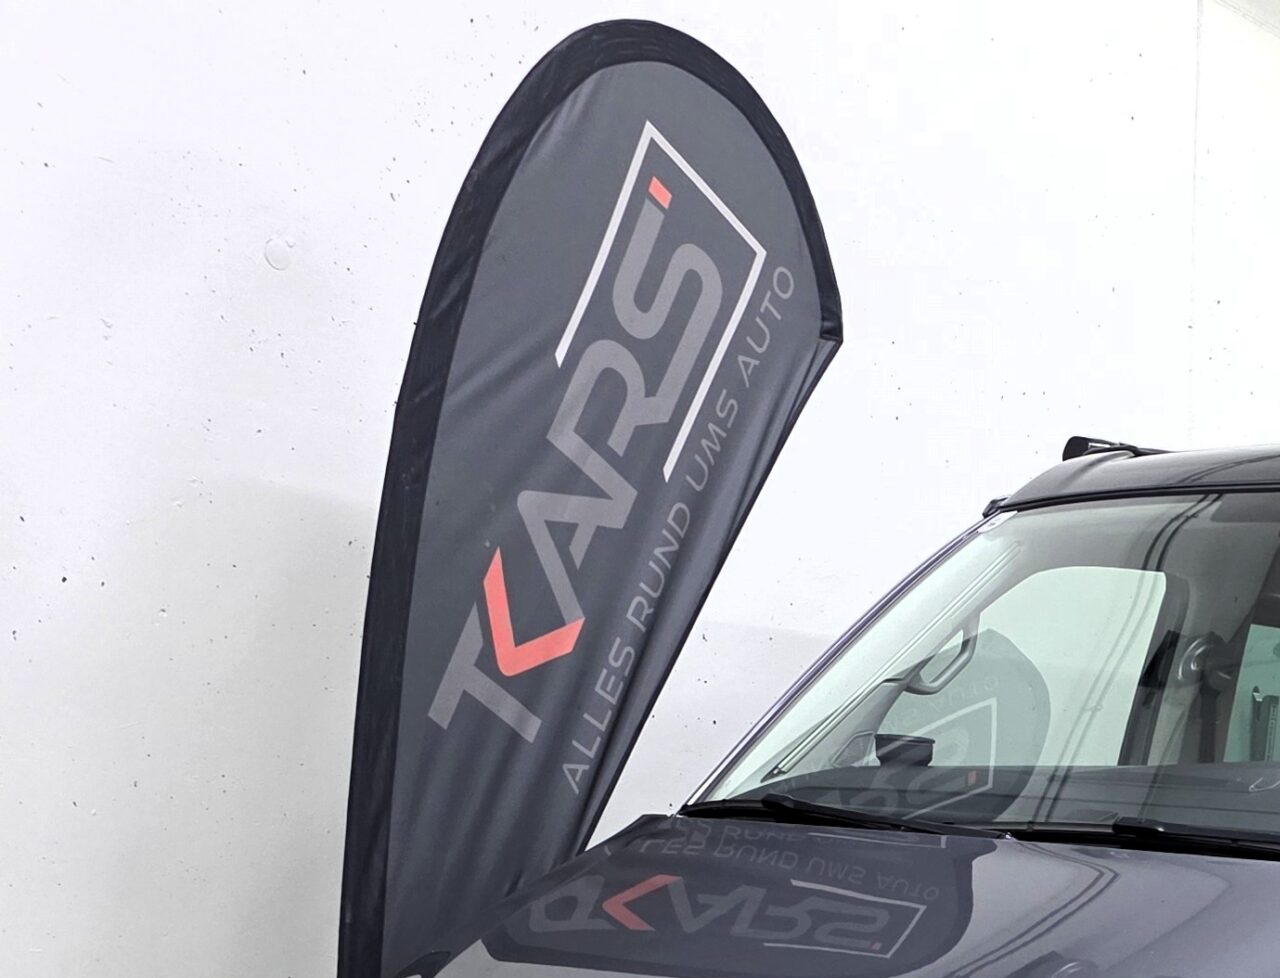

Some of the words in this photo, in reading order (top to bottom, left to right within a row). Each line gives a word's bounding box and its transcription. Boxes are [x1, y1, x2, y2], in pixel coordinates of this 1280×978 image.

[561, 638, 635, 795] ALLES
[625, 500, 691, 634] RUND
[687, 389, 738, 492] UMS
[737, 266, 795, 374] AUTO
